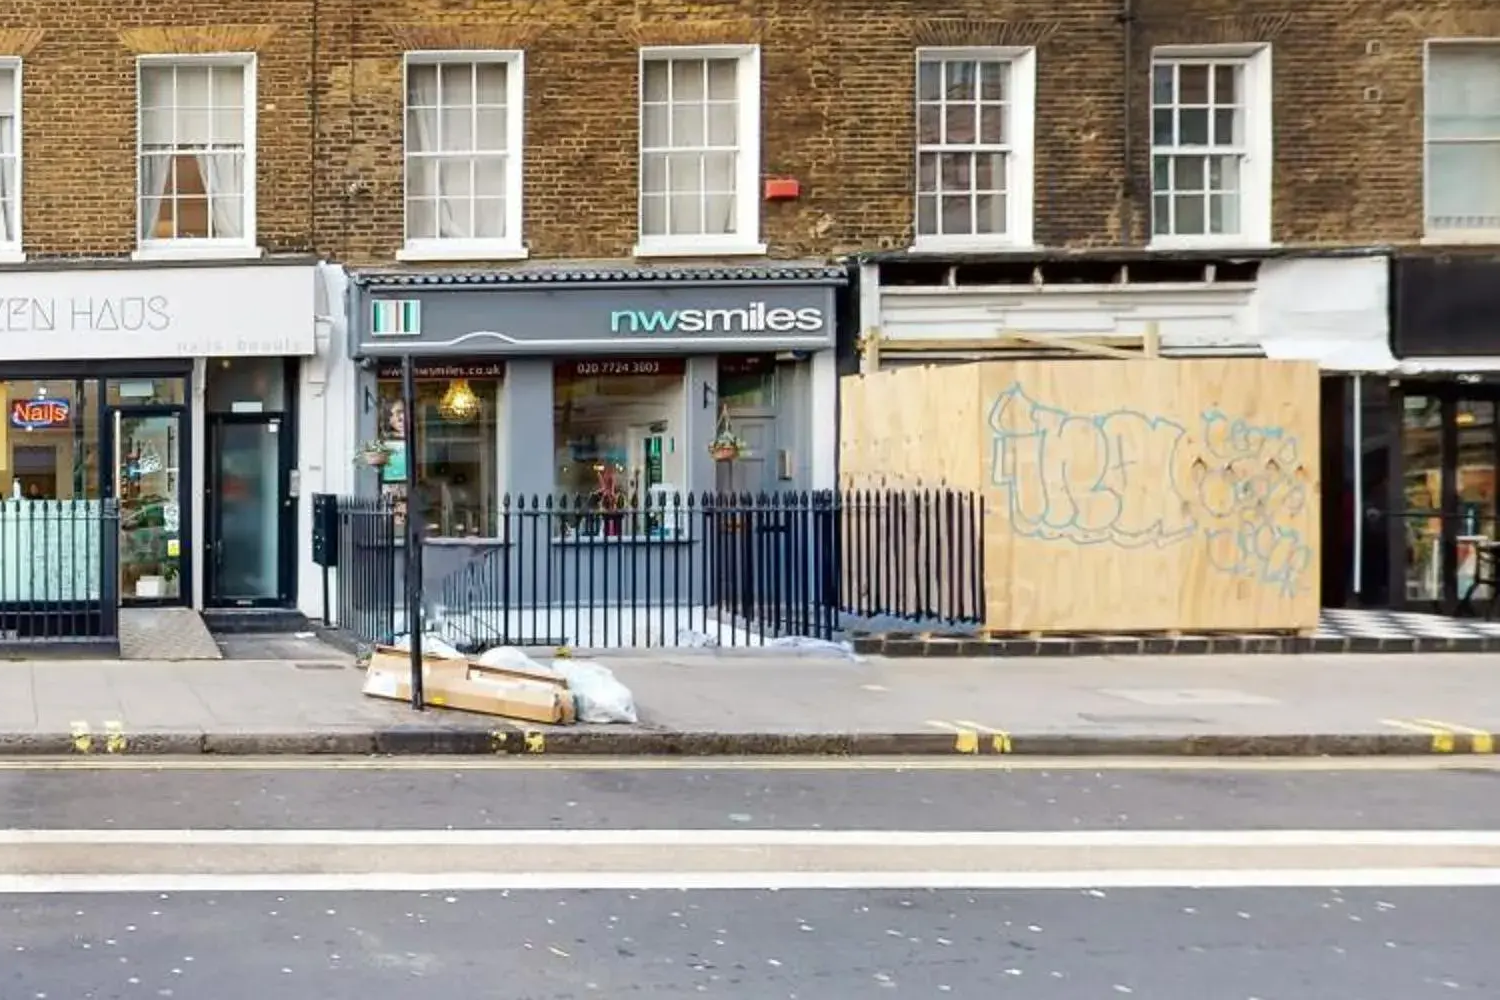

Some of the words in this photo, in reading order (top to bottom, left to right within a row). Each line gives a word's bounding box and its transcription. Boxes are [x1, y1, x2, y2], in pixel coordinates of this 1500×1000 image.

[70, 295, 171, 331] HAUS
[611, 302, 823, 332] nwsmiles
[14, 402, 68, 421] Nails
